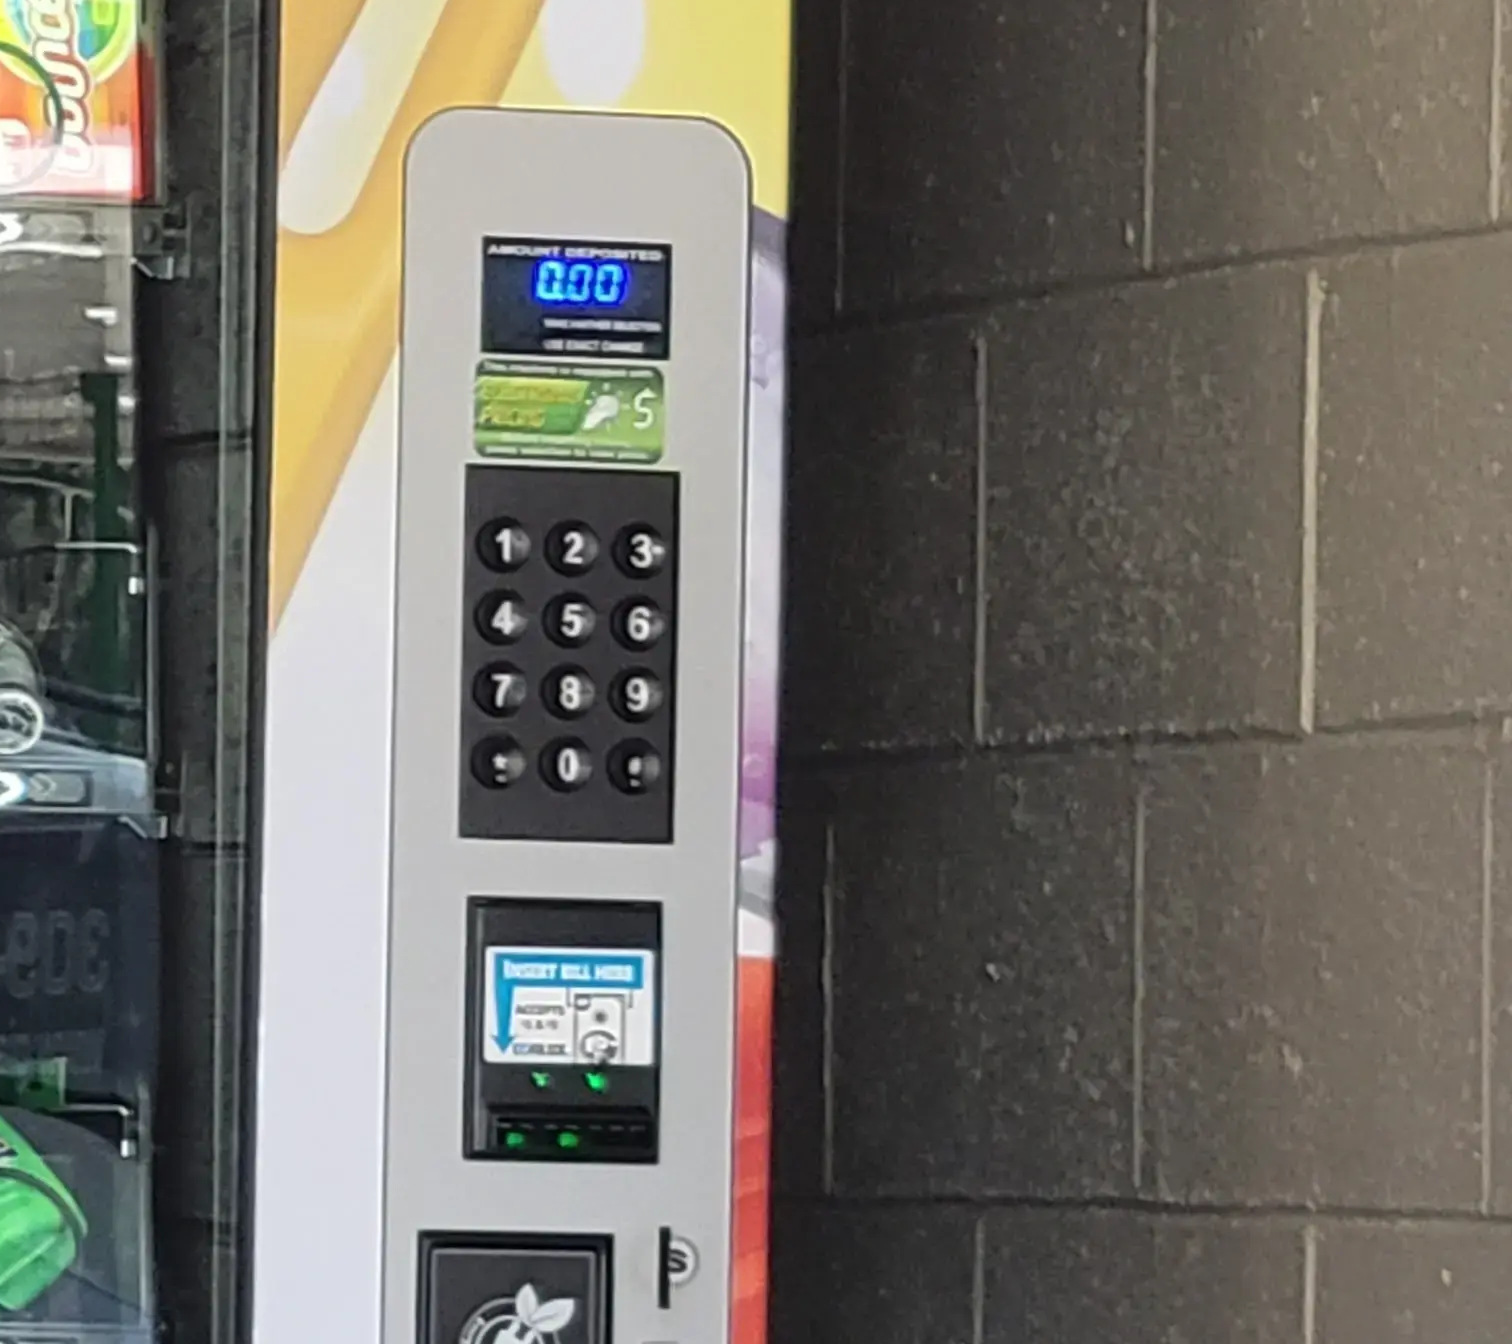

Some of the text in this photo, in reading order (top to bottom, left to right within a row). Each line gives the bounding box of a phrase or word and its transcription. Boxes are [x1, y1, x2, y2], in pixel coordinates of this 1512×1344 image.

[488, 244, 663, 261] AMOUNT DEPOSITED
[537, 260, 624, 303] 0.00
[495, 528, 653, 568] 1 2 3
[491, 600, 651, 641] 4 5 6
[491, 673, 649, 712] 7 8 9
[557, 748, 579, 782] 0
[560, 963, 592, 980] BILL
